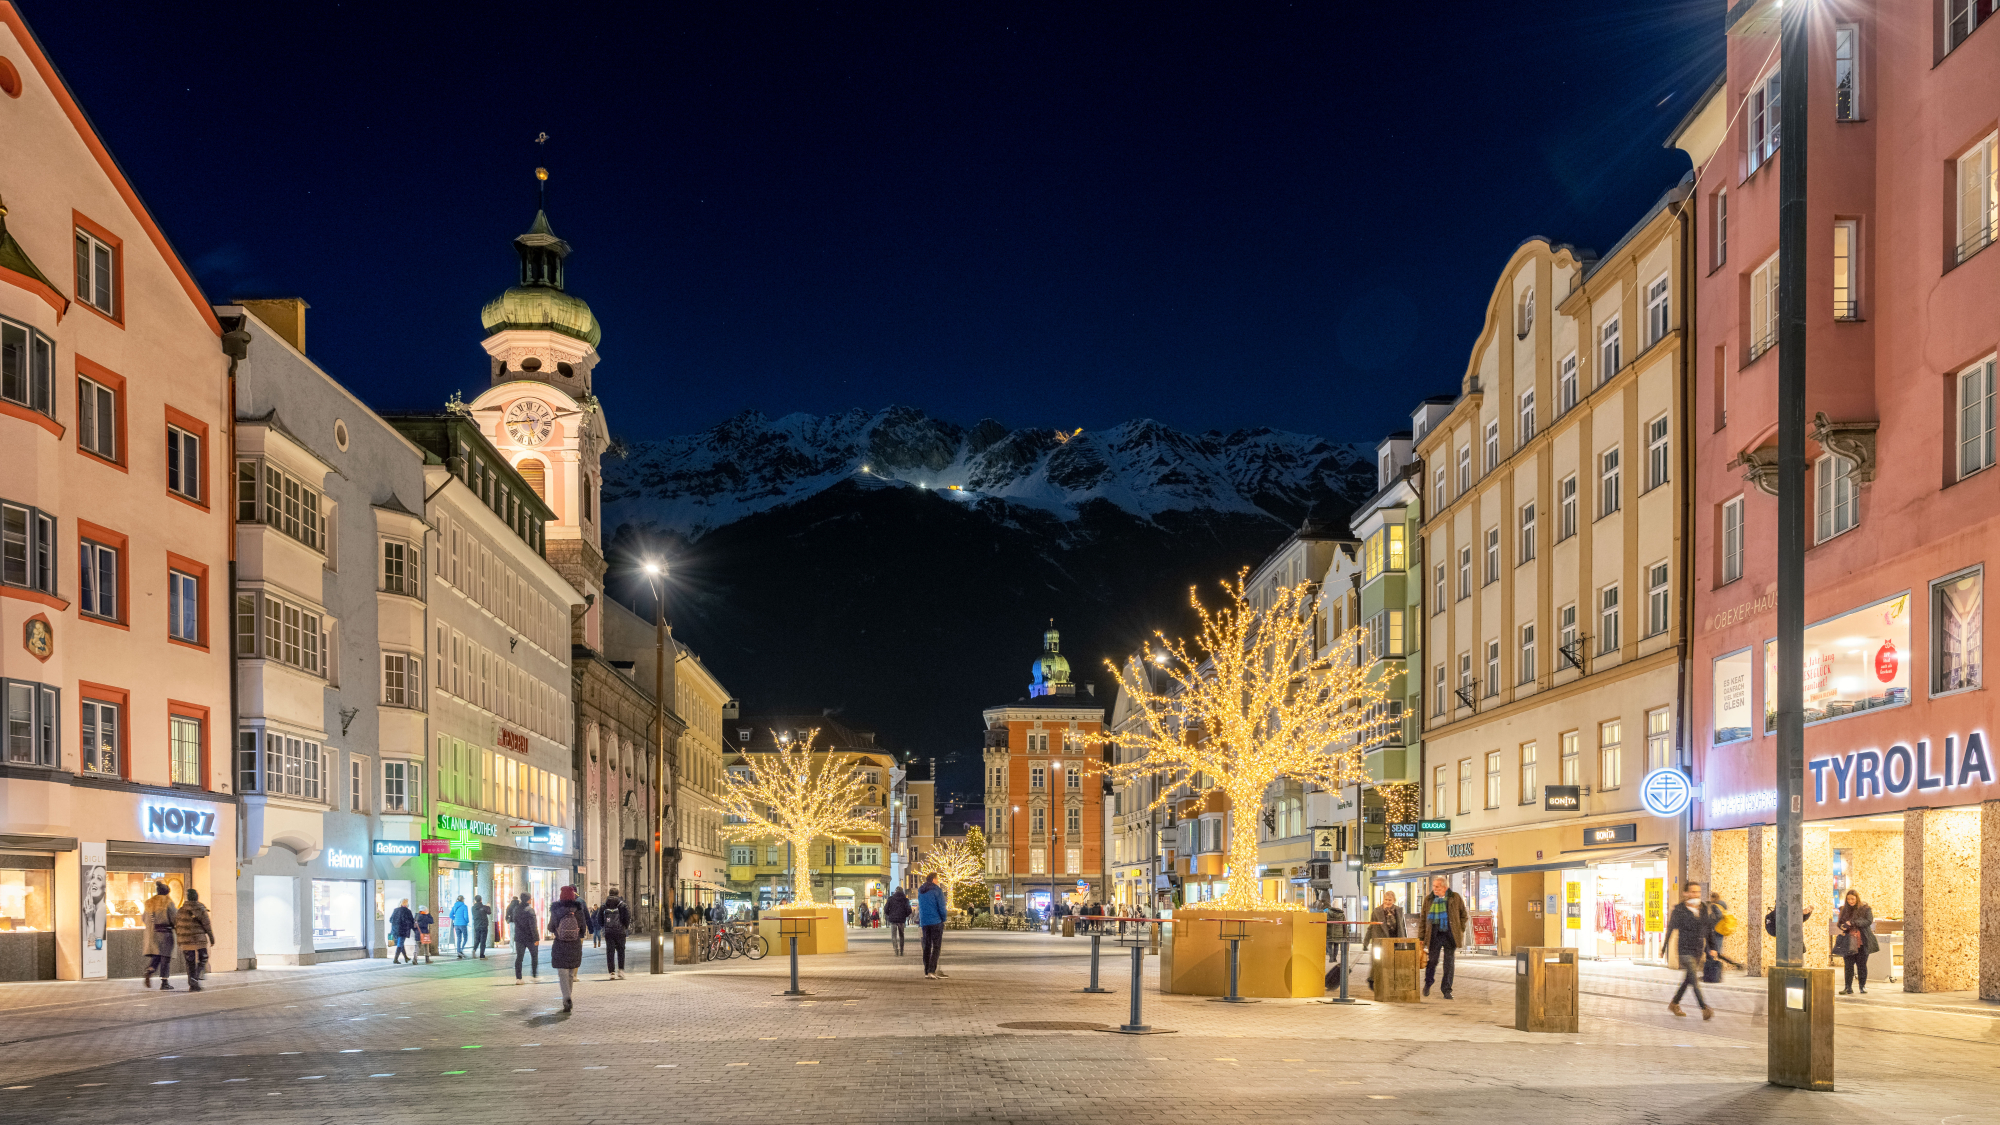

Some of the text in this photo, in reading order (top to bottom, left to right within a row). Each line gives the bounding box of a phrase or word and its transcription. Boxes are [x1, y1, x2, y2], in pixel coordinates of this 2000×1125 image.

[1803, 664, 1831, 681] ESEGLÜCK
[1723, 674, 1745, 688] ES KEAT
[1723, 690, 1745, 701] VIEL MEHR
[1723, 697, 1745, 711] GLESN
[1808, 732, 1992, 803] TYROLIA
[1549, 796, 1577, 806] BONITA
[148, 805, 215, 837] NORZ
[470, 820, 498, 837] APOTHEKE
[1391, 824, 1416, 833] SENSEI
[1596, 828, 1615, 841] BONITA
[1447, 842, 1474, 858] DOUGLAS
[84, 855, 104, 863] BIGLI
